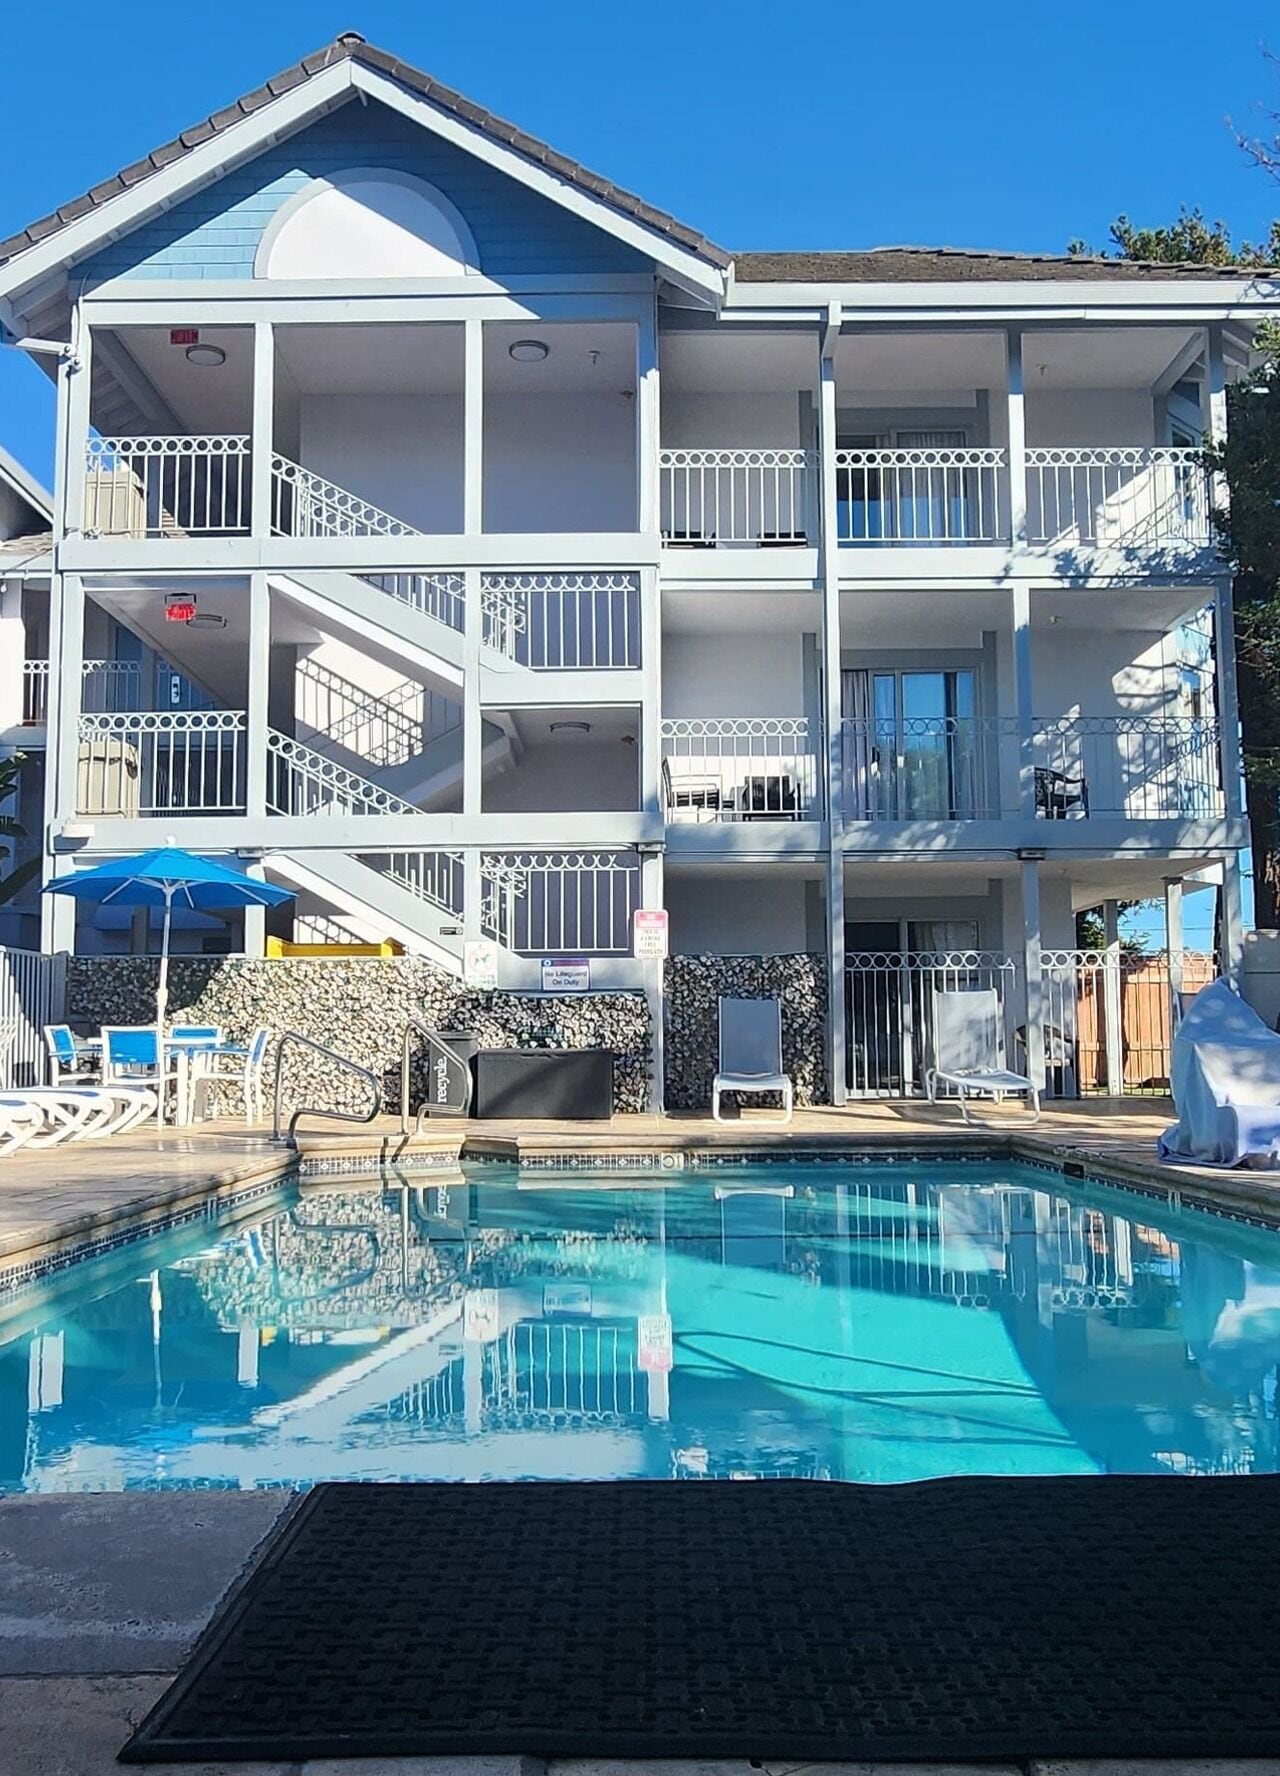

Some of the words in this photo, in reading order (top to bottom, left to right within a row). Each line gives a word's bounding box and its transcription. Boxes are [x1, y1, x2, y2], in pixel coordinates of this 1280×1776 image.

[555, 970, 587, 979] Lifeguard
[552, 978, 562, 986] On
[563, 978, 580, 987] Duty
[433, 1055, 450, 1103] recycle
